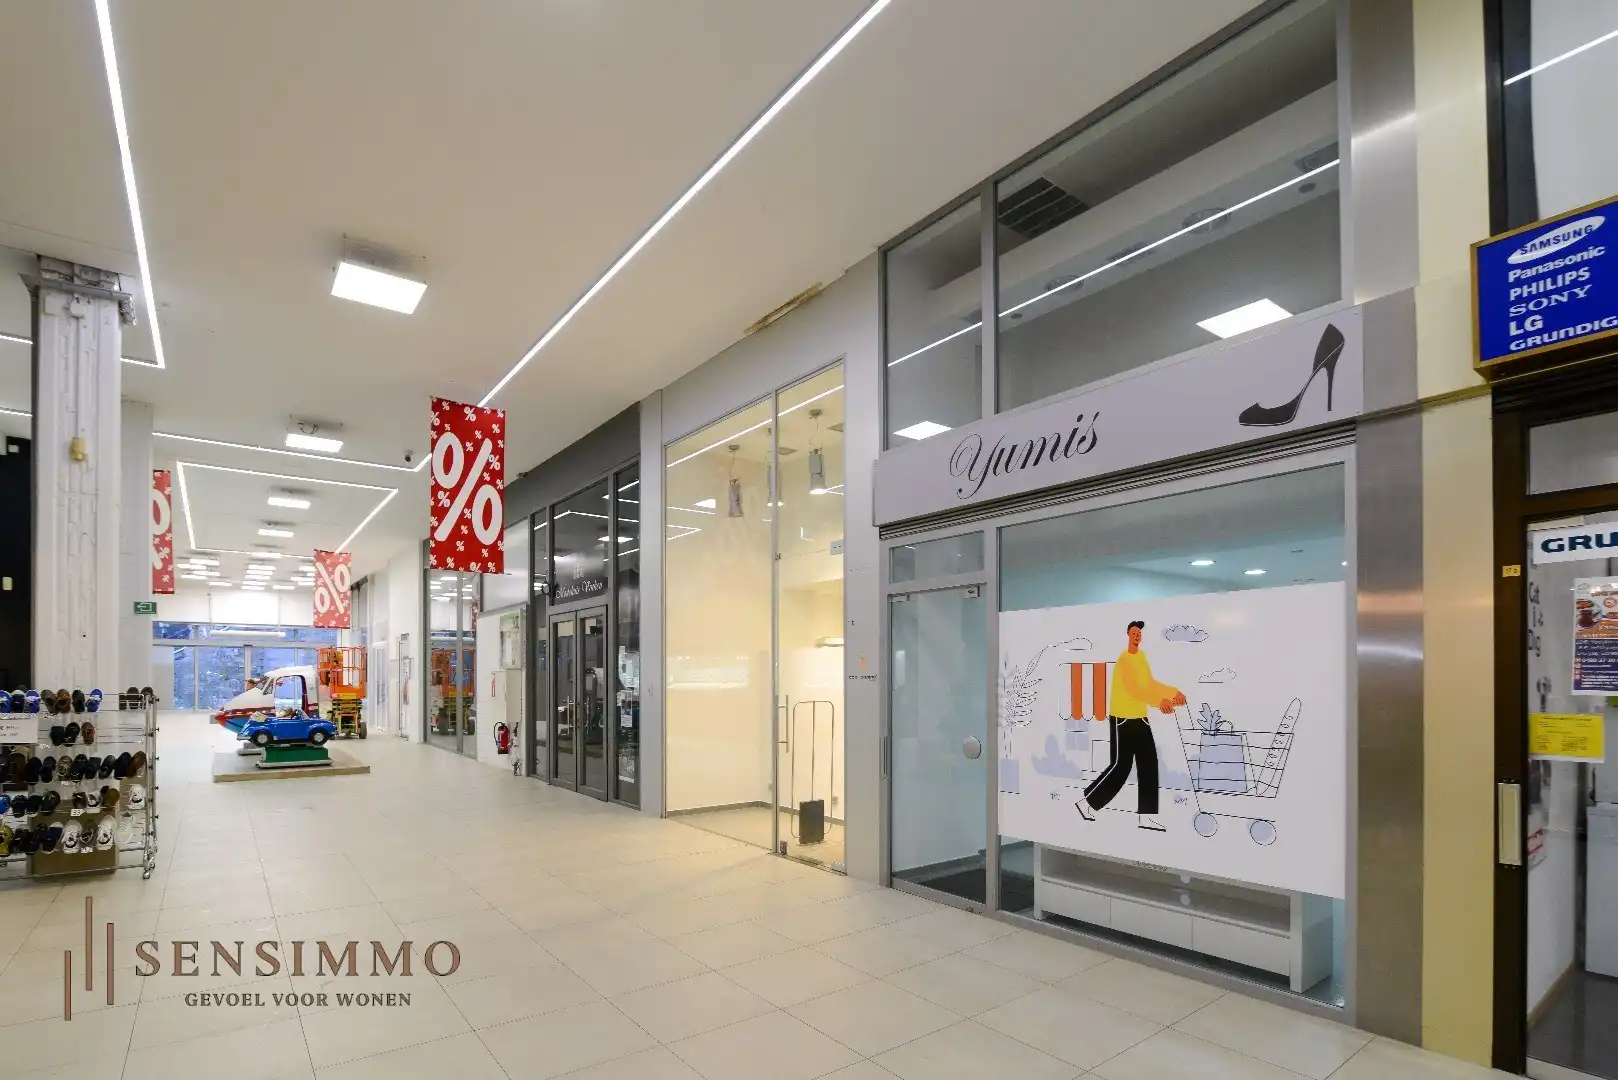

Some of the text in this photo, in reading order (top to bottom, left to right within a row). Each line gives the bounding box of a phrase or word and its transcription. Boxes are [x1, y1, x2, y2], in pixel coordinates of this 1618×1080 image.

[1520, 224, 1593, 255] SAMSUNG
[1508, 246, 1606, 283] Panasonic
[1509, 267, 1591, 301] PHILIPS
[1509, 285, 1592, 317] SONY
[1508, 314, 1544, 337] LG
[1509, 315, 1618, 351] GRUNDIG
